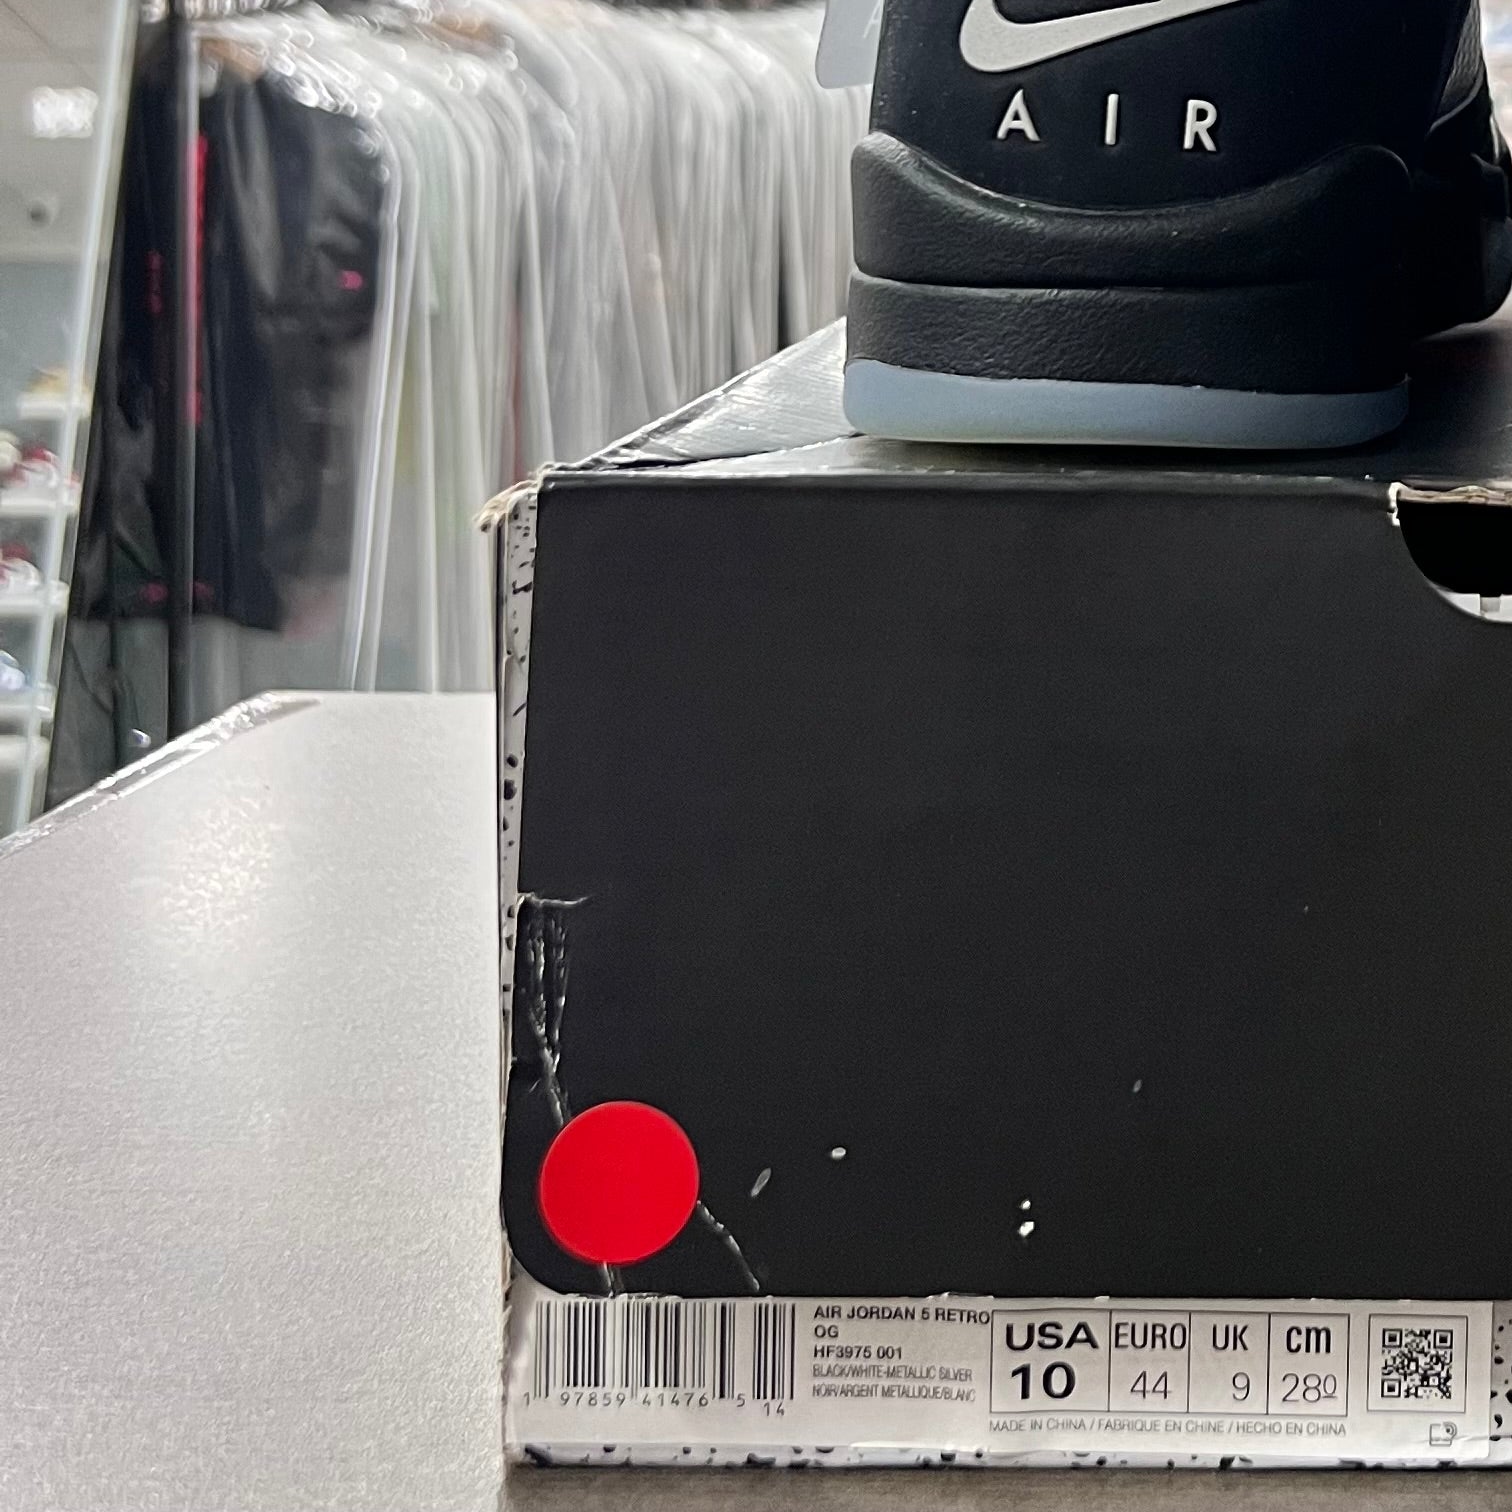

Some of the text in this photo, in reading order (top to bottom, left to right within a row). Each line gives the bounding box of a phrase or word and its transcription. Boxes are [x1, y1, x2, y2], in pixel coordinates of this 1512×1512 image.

[997, 88, 1217, 152] AIR
[814, 1305, 990, 1325] AIR JORDAN 5 RETRO
[814, 1325, 839, 1338] OG
[1005, 1321, 1100, 1350] USA
[1114, 1322, 1188, 1349] EURO
[1212, 1324, 1249, 1350] UK
[1285, 1325, 1332, 1354] cm
[813, 1344, 902, 1359] HF3975 001
[812, 1363, 972, 1382] BLACK/WHITE-METALLIC SILVER
[1010, 1361, 1076, 1400] 10
[1130, 1370, 1171, 1400] 44
[1232, 1372, 1251, 1401] 9
[560, 1392, 626, 1408] 97859
[642, 1392, 709, 1407] 41476
[763, 1402, 785, 1416] 14
[989, 1419, 1027, 1432] MADE
[1030, 1419, 1042, 1431] IN
[1046, 1419, 1087, 1431] CHINA
[1098, 1419, 1161, 1432] FABRIQUE
[1165, 1420, 1182, 1432] EN
[1185, 1420, 1224, 1433] CHINE
[1236, 1421, 1282, 1434] HECHO
[1285, 1422, 1302, 1434] EN
[1306, 1423, 1347, 1435] CHINA
